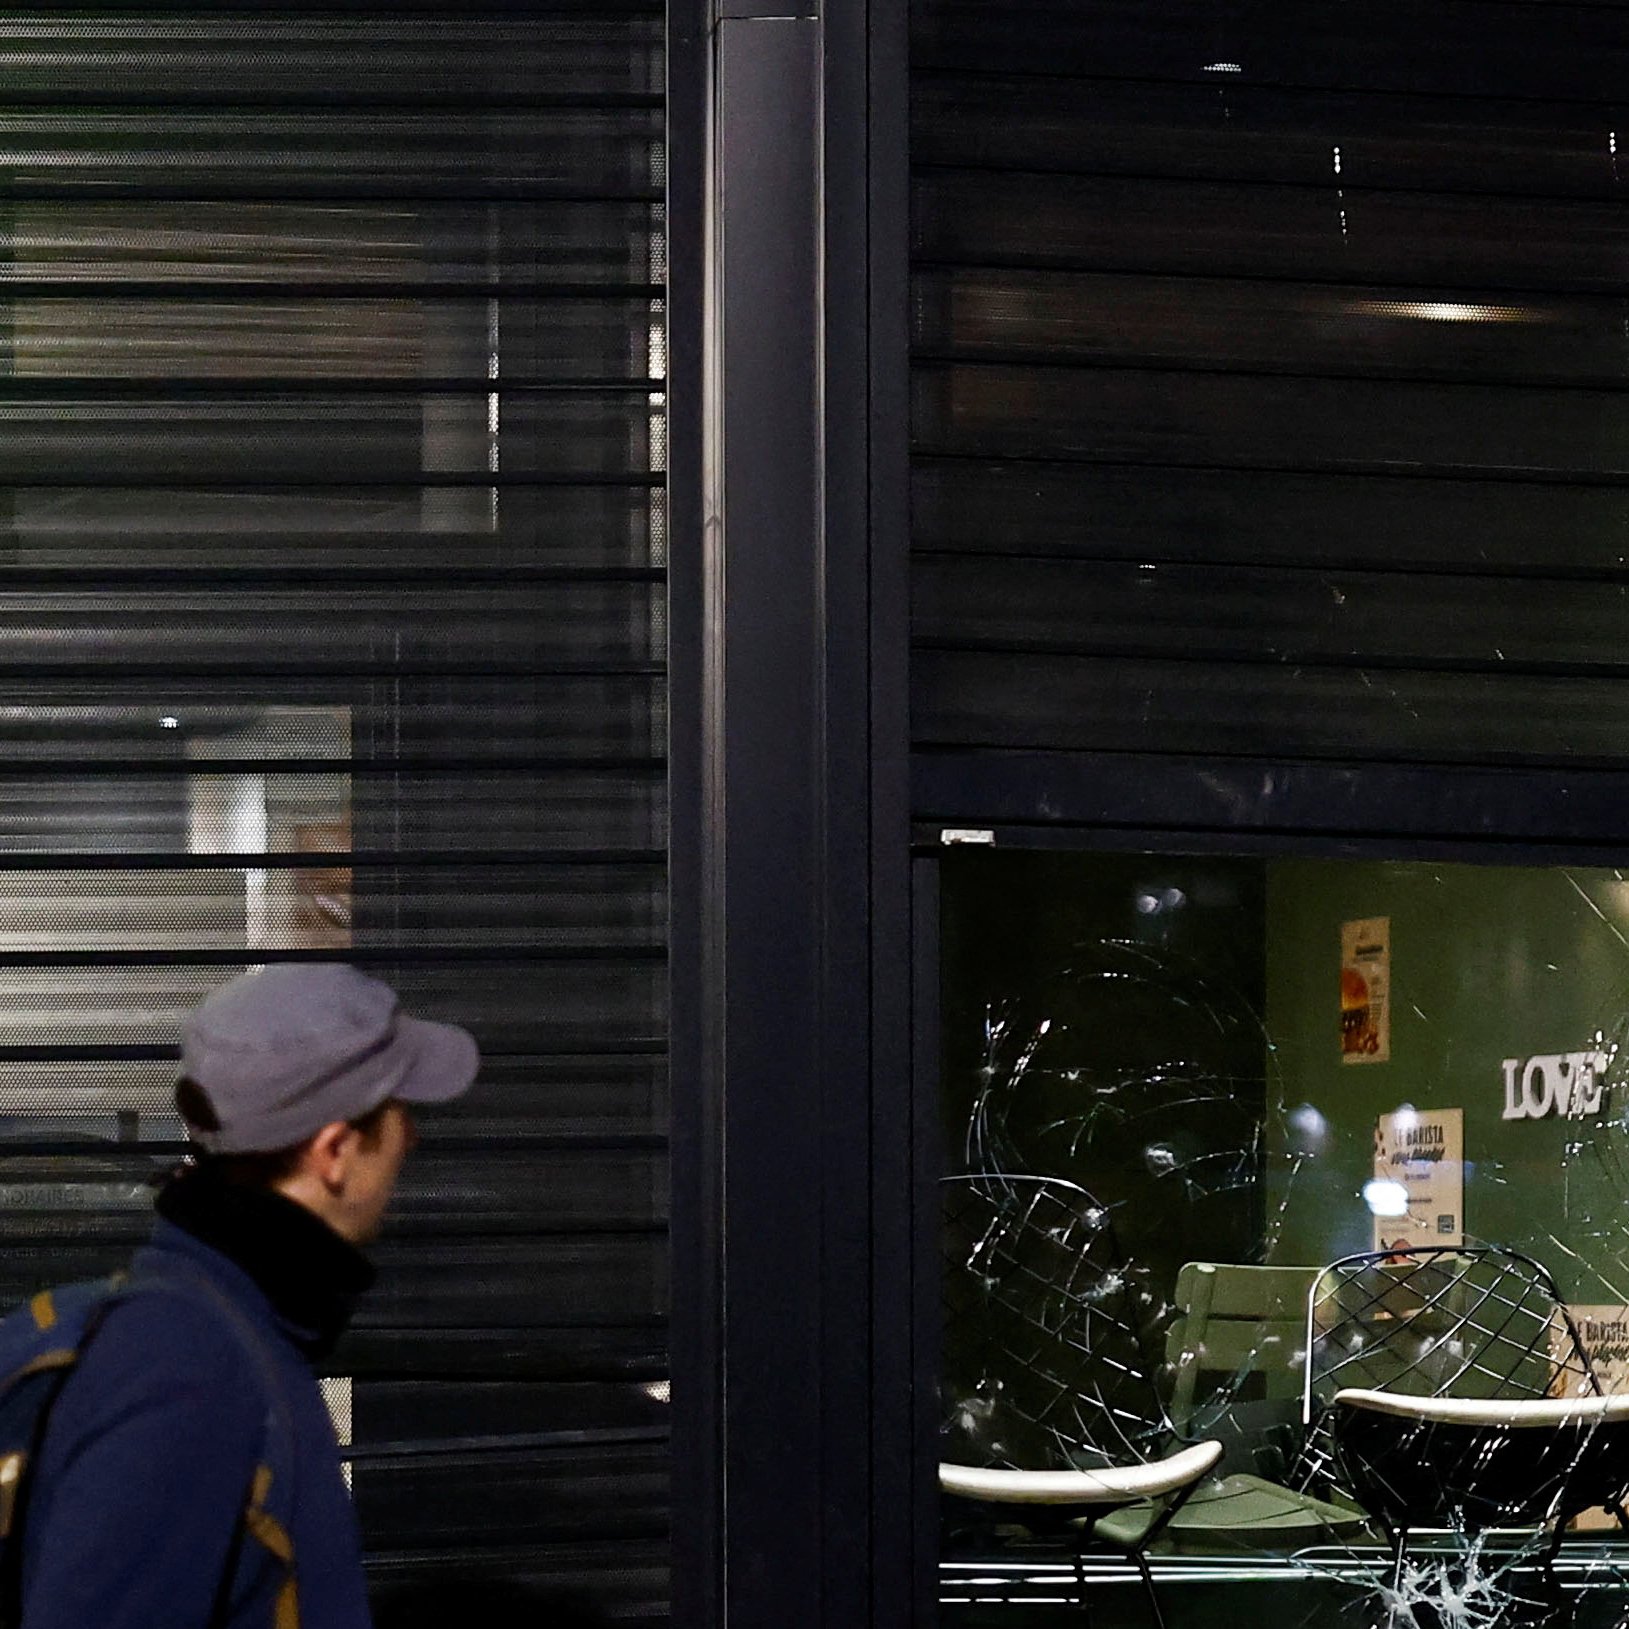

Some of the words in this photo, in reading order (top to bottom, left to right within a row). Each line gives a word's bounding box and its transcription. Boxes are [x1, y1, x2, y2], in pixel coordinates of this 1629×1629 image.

[1502, 1050, 1607, 1119] LOVE
[1406, 1124, 1444, 1146] BARISTA
[1587, 1320, 1629, 1342] BARISTA
